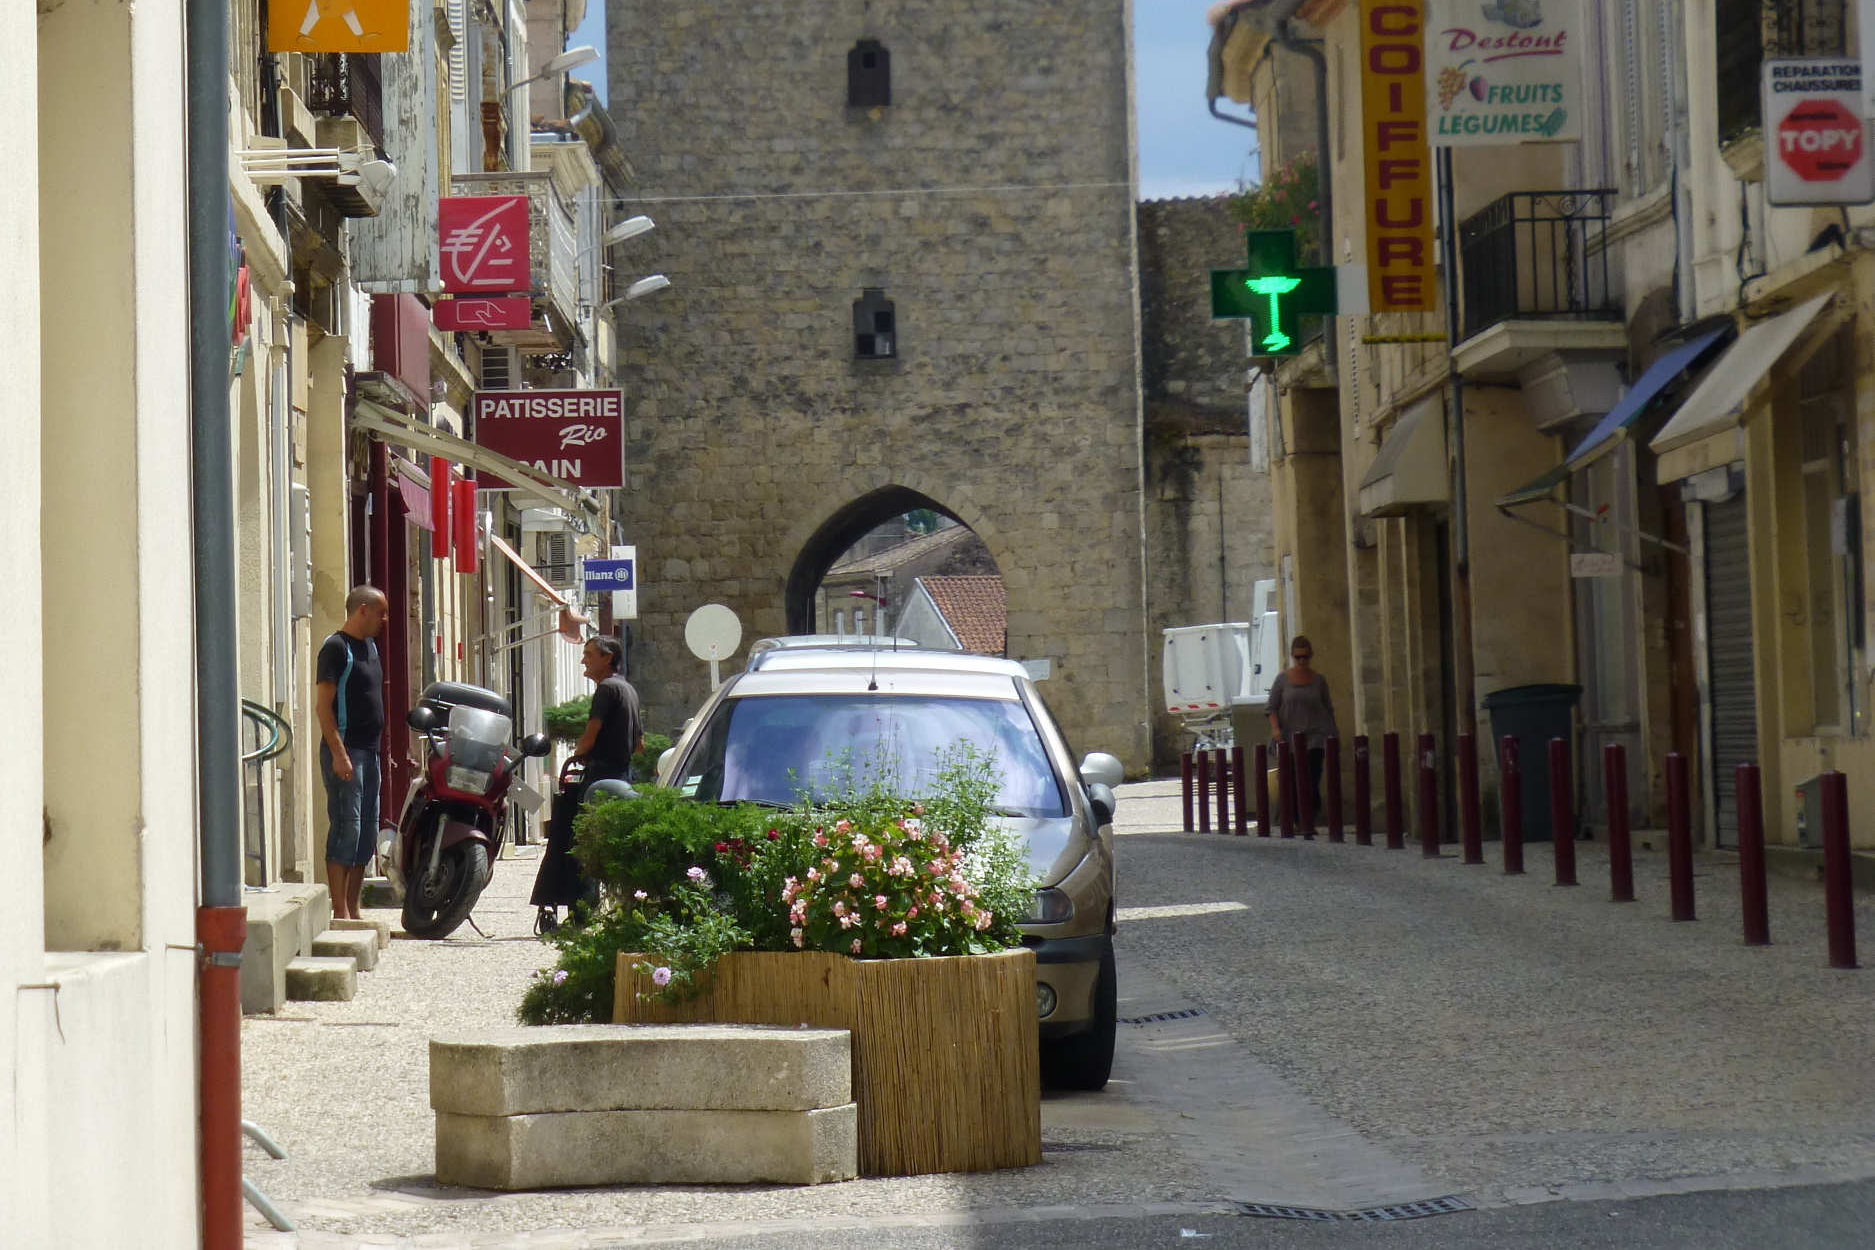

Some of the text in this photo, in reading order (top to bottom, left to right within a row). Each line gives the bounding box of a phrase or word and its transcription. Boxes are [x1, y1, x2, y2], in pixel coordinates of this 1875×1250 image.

[1487, 83, 1563, 104] FRUITS
[1438, 109, 1544, 135] LÉGUMES
[1781, 129, 1859, 152] TOPY
[1369, 5, 1424, 306] COIFFURE
[480, 397, 618, 419] PATISSERIE
[558, 424, 607, 450] Rio
[519, 459, 581, 479] AIN
[585, 571, 614, 581] llianz
